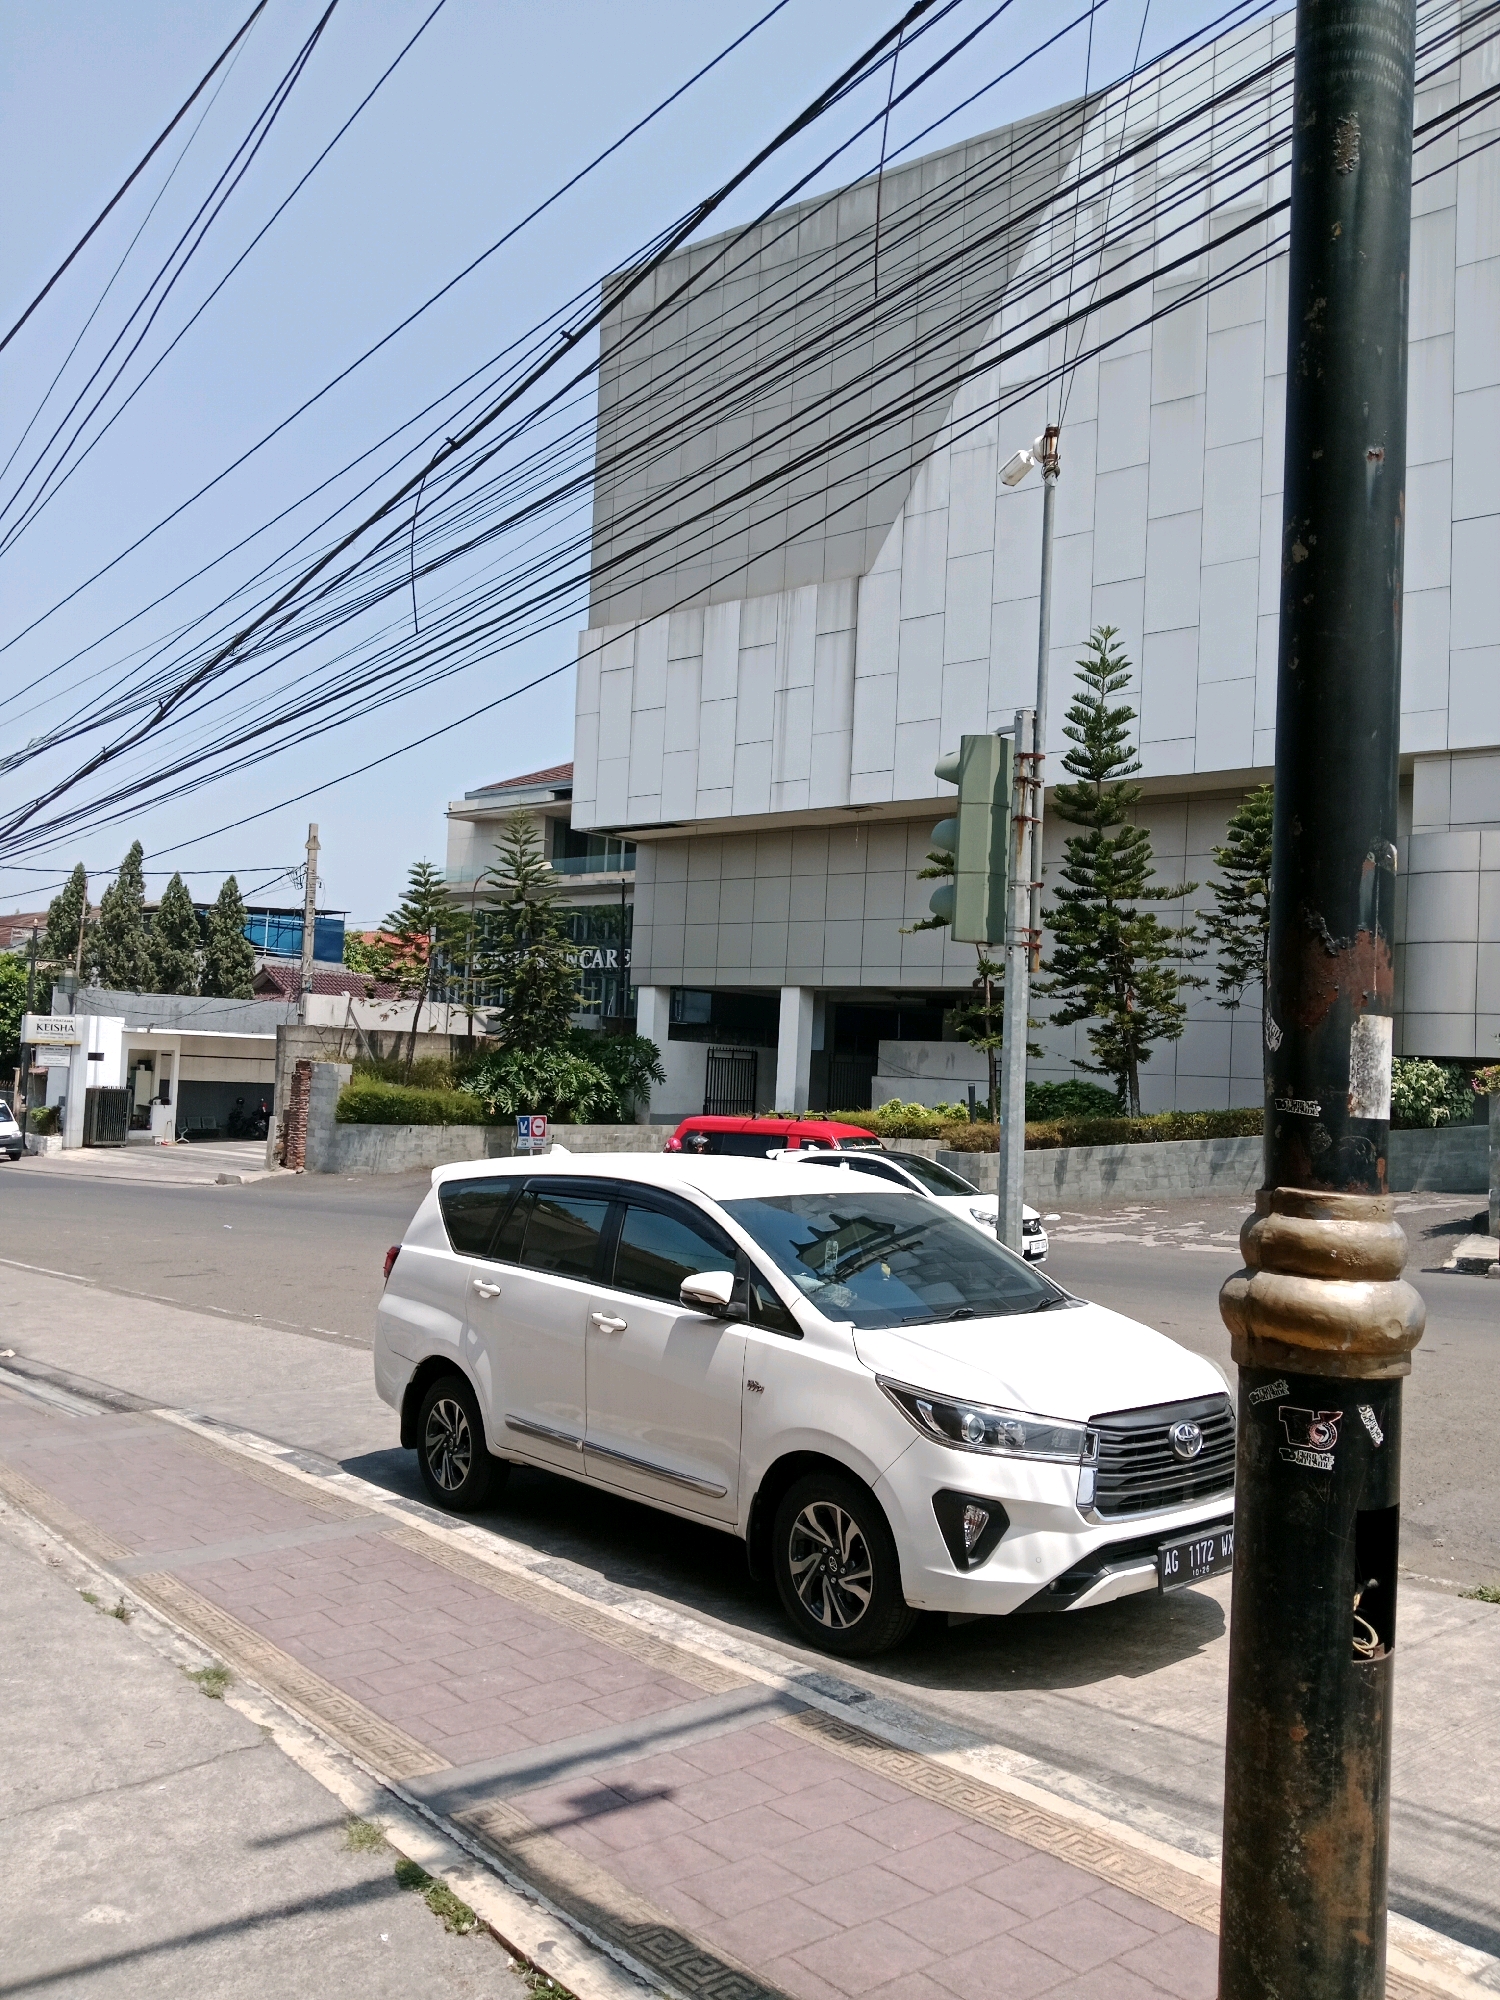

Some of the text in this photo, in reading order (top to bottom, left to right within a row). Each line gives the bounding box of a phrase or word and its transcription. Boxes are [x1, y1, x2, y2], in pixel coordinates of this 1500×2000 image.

[36, 1023, 75, 1032] KEISHA
[1164, 1549, 1179, 1575] AG
[1189, 1540, 1214, 1567] 1172
